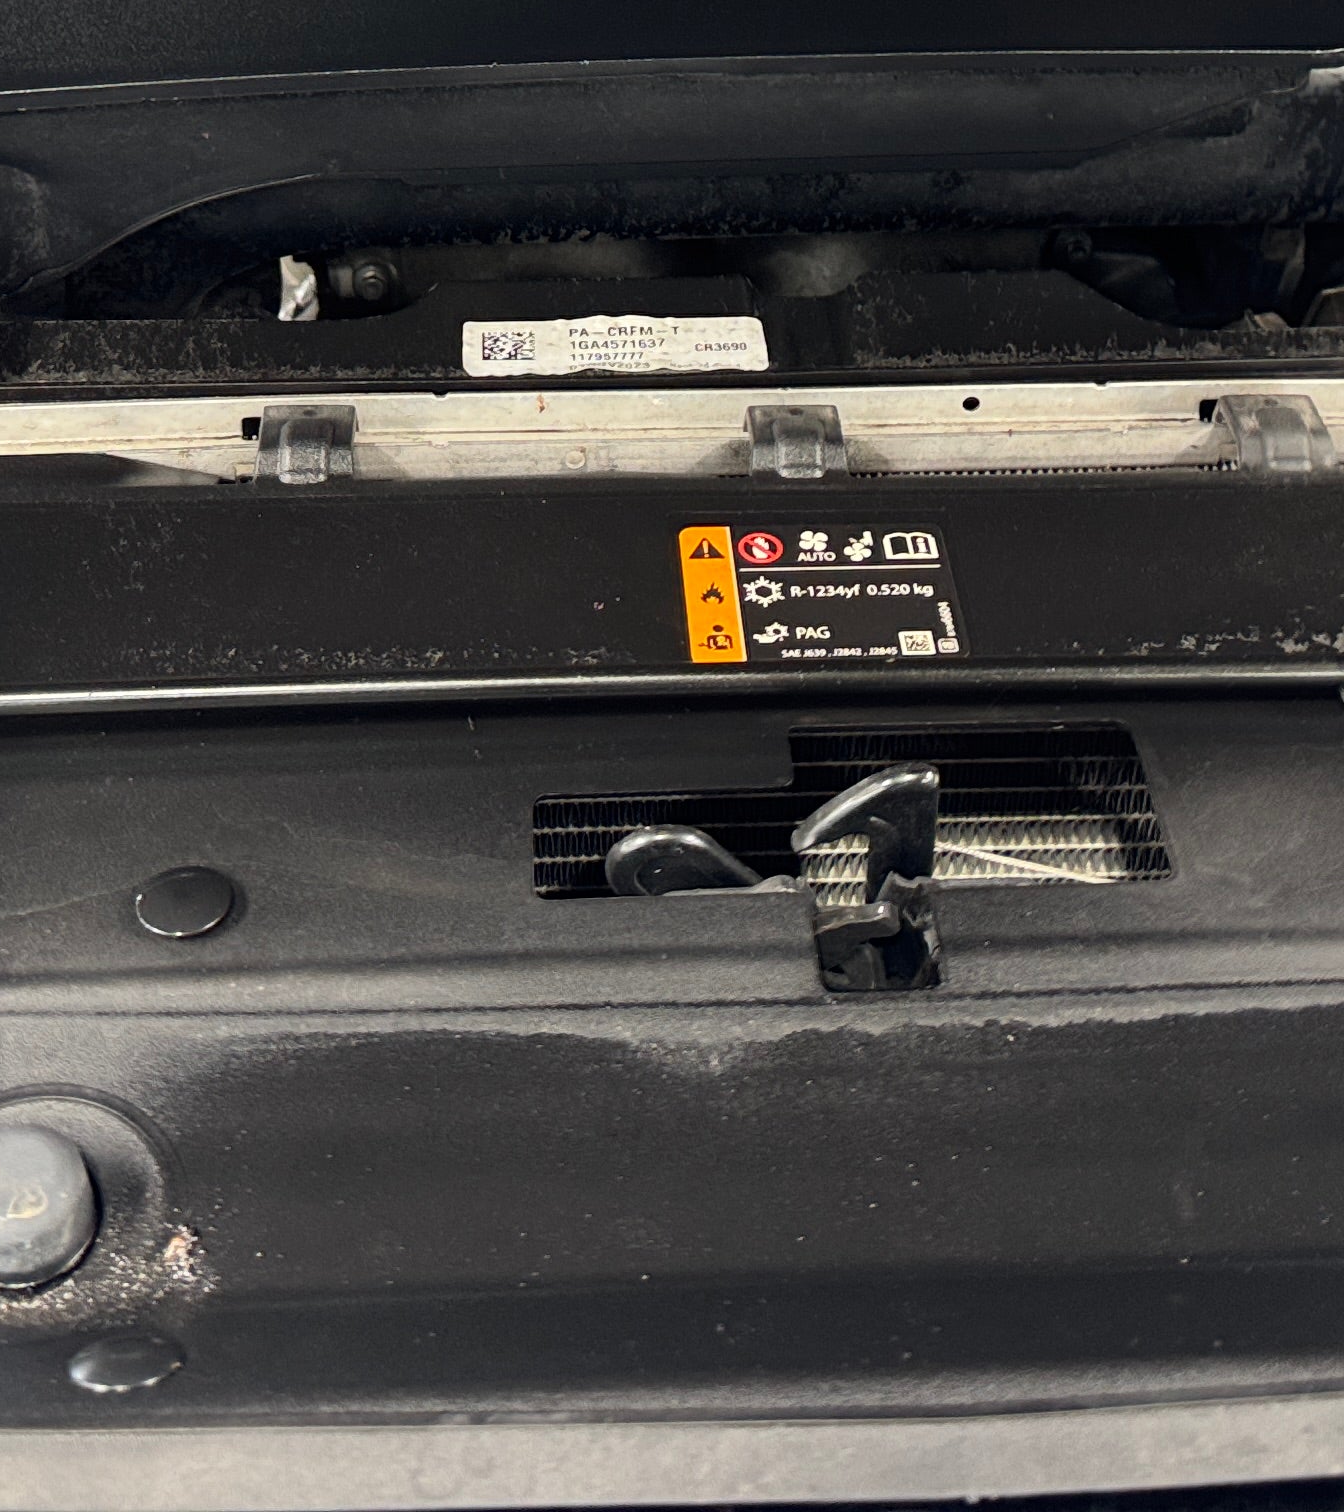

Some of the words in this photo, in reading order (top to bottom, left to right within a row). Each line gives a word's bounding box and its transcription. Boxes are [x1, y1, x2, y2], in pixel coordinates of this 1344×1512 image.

[694, 342, 747, 352] CR3690
[797, 551, 837, 563] AUTO
[789, 583, 861, 599] R-1234yf
[866, 583, 911, 596] 0.520
[912, 582, 935, 597] kg
[795, 626, 831, 640] PAG
[780, 648, 802, 658] SAE
